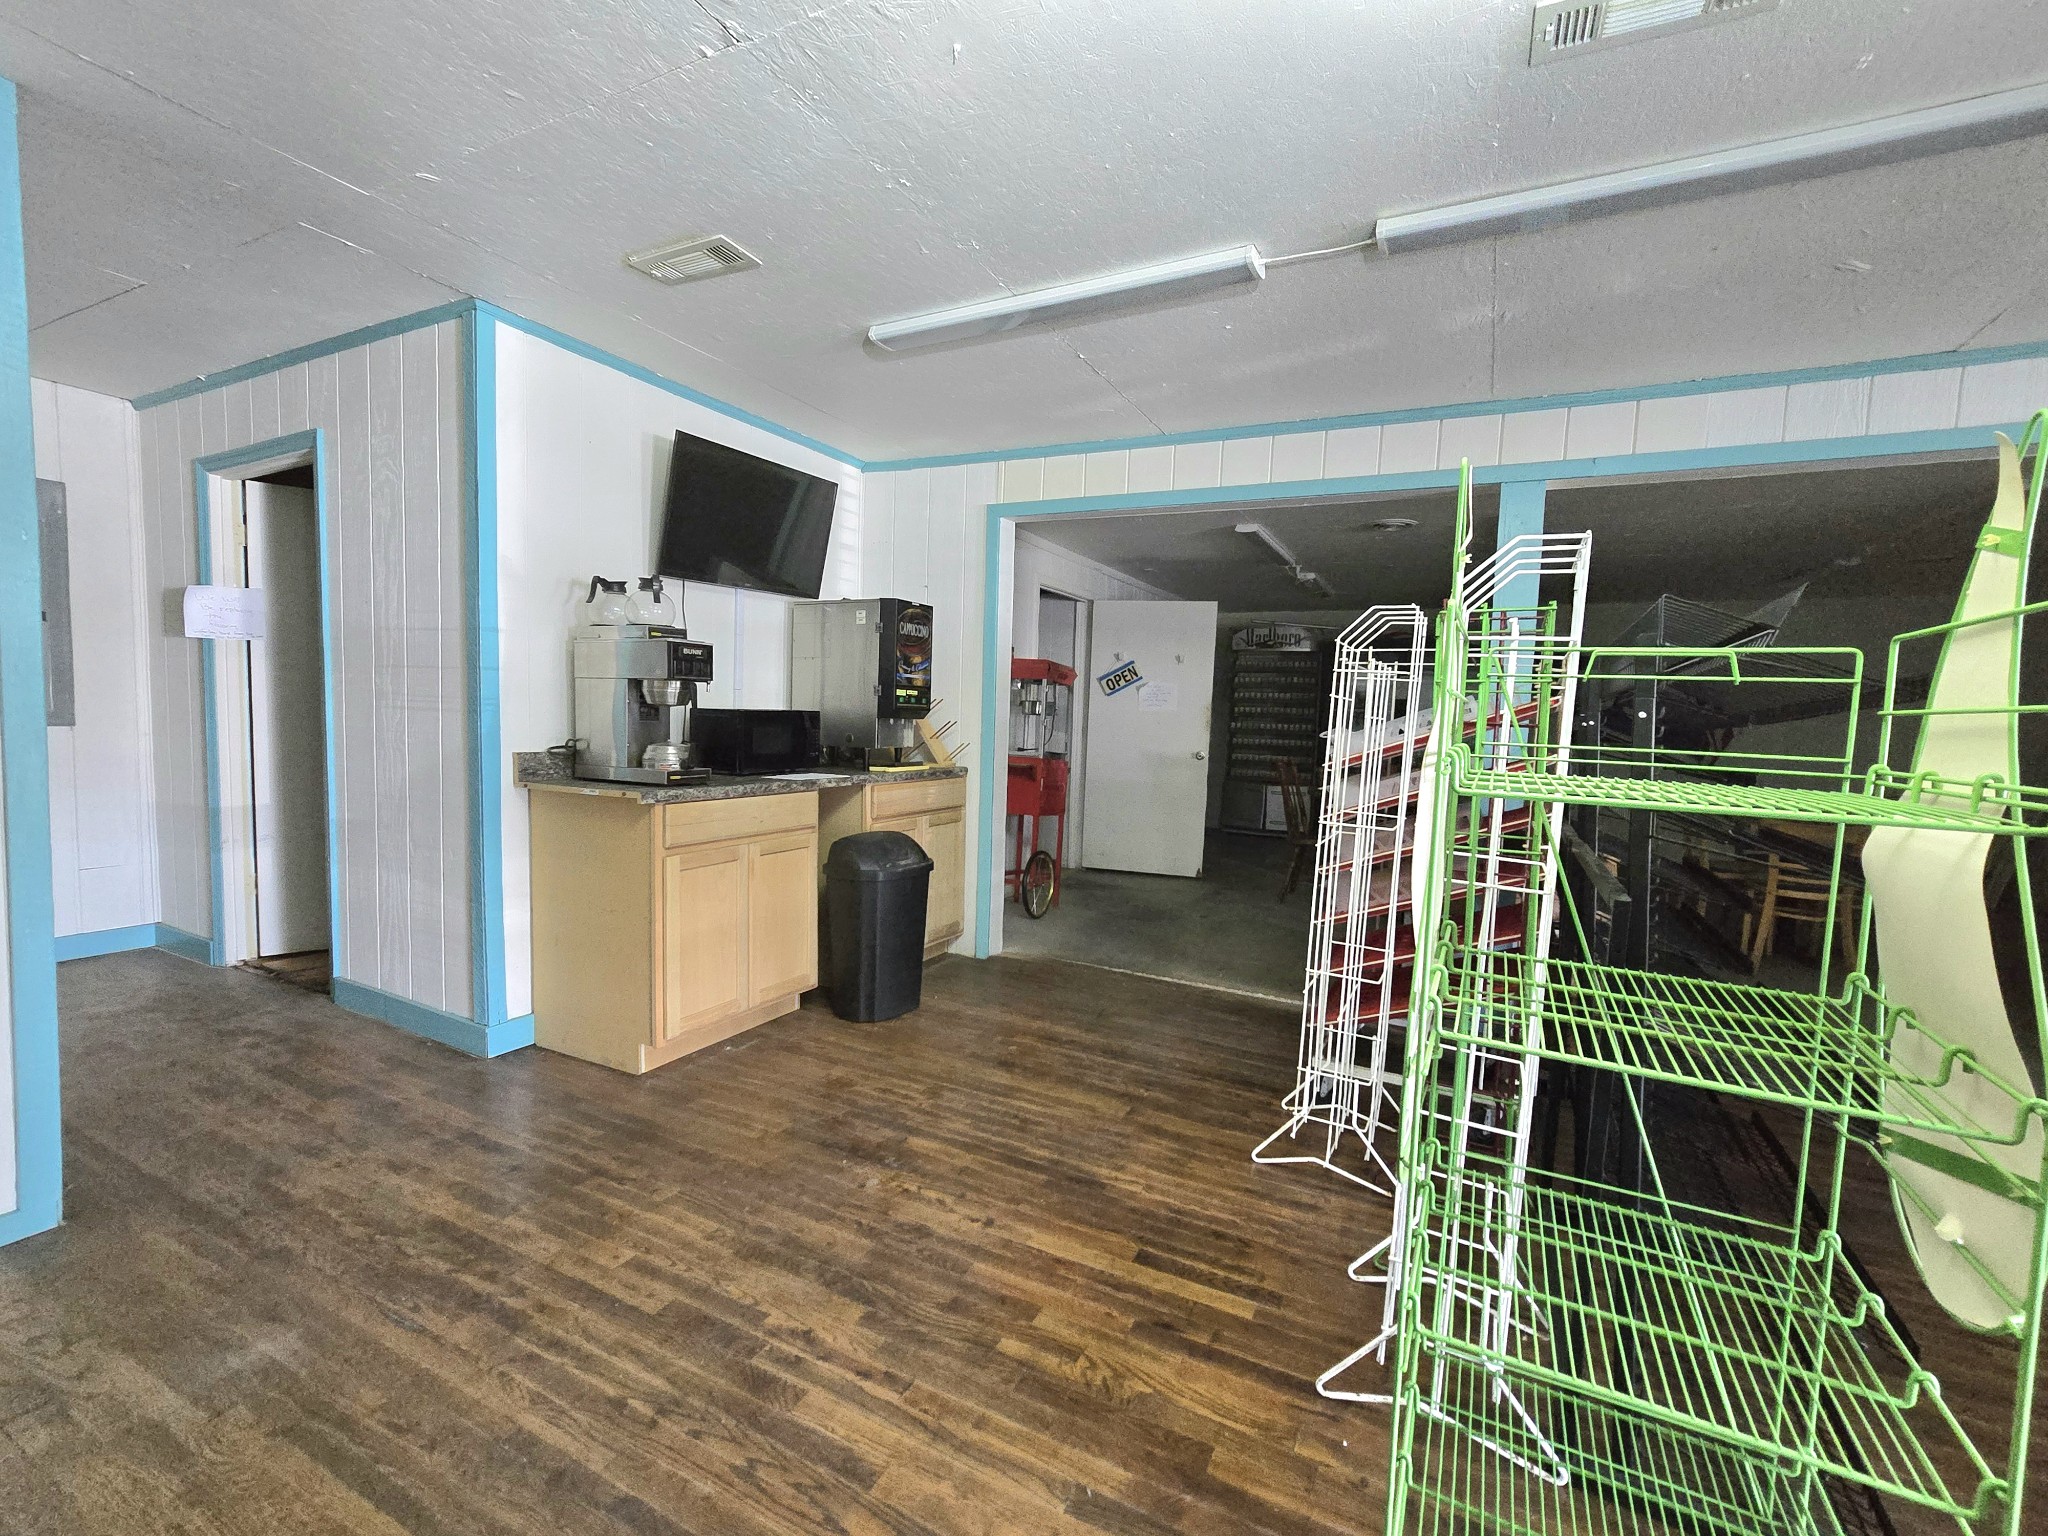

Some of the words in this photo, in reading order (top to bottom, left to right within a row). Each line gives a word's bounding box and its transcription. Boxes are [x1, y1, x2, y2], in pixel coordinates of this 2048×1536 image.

[899, 621, 930, 638] CAPPUCCINO
[683, 647, 703, 656] BUNN
[1105, 665, 1139, 691] OPEN
